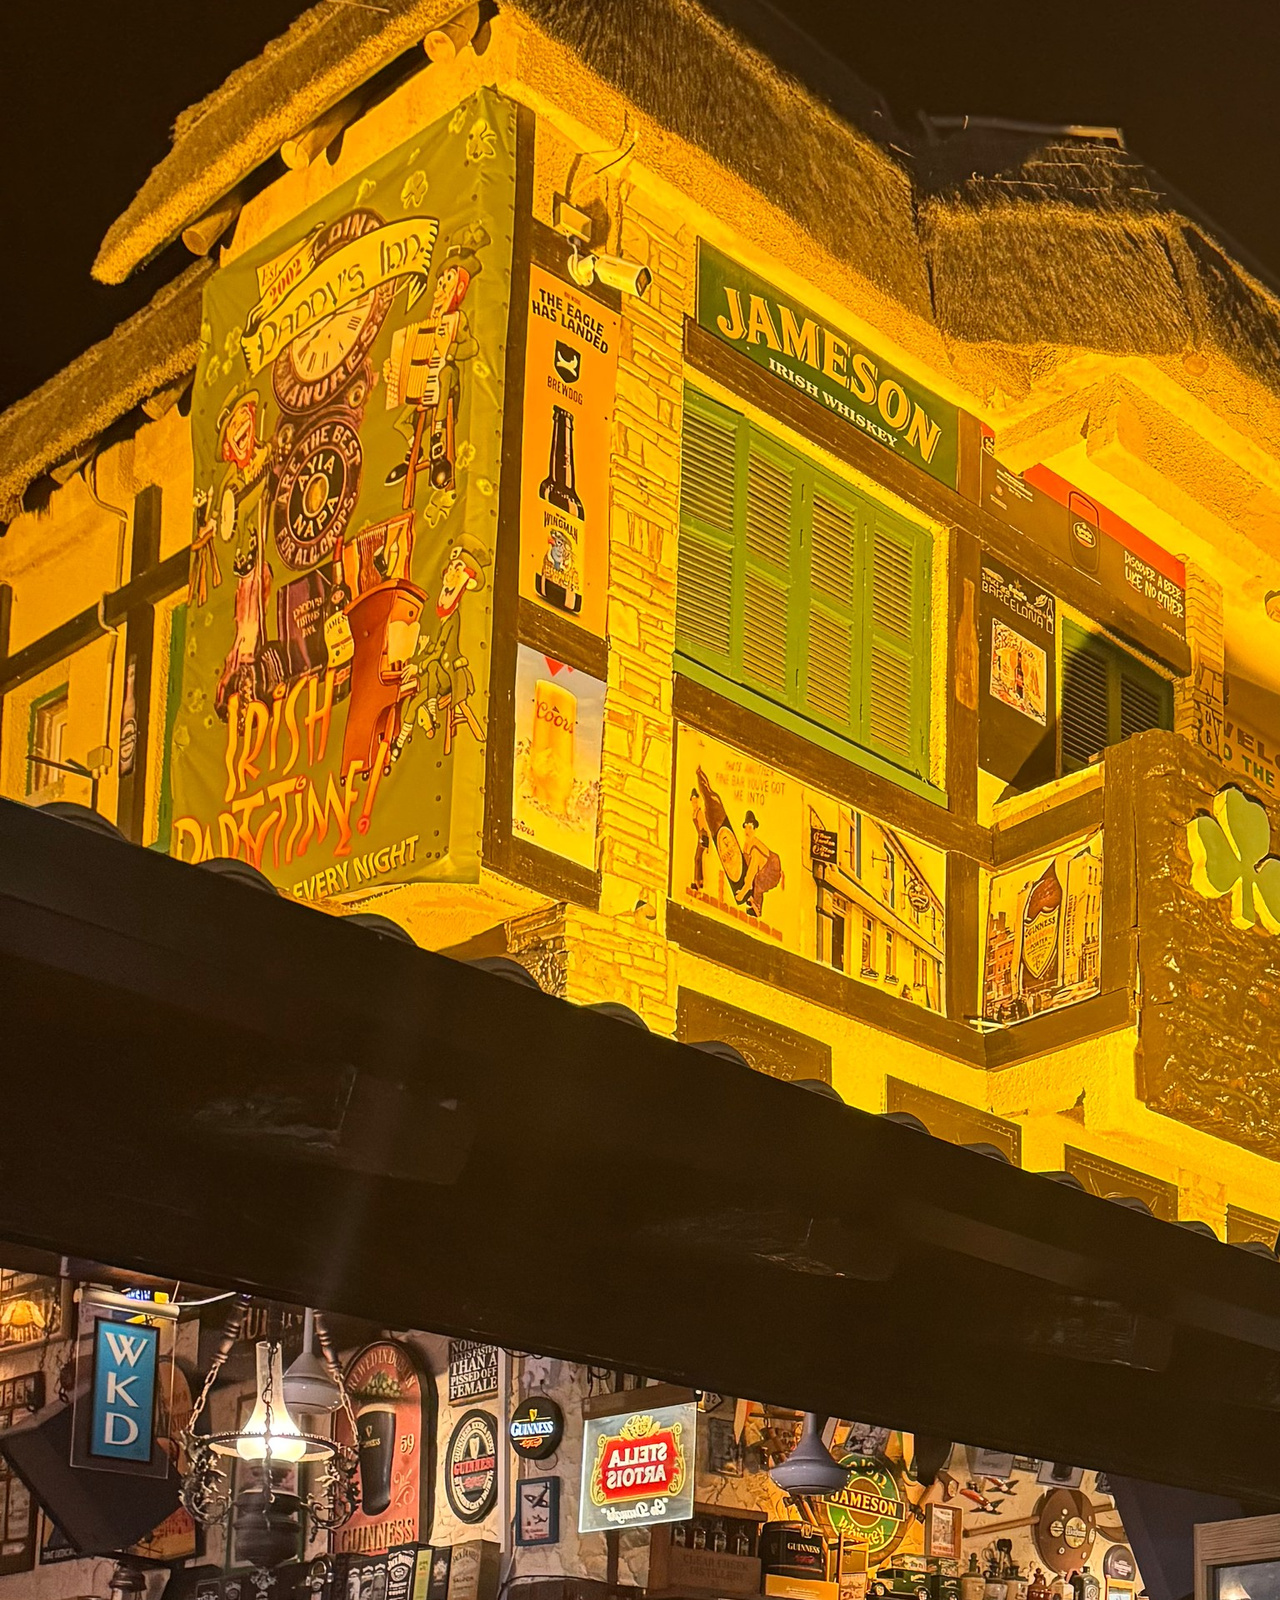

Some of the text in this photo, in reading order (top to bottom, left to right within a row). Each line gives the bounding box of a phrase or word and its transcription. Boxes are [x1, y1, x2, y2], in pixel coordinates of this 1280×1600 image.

[269, 258, 303, 307] 2002
[531, 300, 609, 355] HAS LANDED
[538, 287, 564, 311] THE
[566, 303, 605, 338] EAGLE
[547, 375, 584, 406] BREWDOG
[716, 286, 942, 464] JAMESON
[768, 357, 898, 449] IRISH WHISKEY
[277, 425, 362, 504] ARE THE BEST
[297, 453, 336, 492] AYIA
[293, 495, 340, 538] NAPA
[543, 510, 579, 546] WINGMAN
[1124, 550, 1156, 582] DISCOVER
[1157, 575, 1163, 589] A
[982, 580, 1044, 629] BARCELONA
[1125, 565, 1184, 618] LIKE NO OTHER
[225, 668, 335, 803] IRISH
[535, 700, 575, 735] Coors
[770, 781, 786, 797] GOT
[1241, 754, 1277, 790] THE
[733, 789, 766, 807] ME INTO
[512, 817, 536, 839] Coors
[292, 834, 420, 902] EVERY NIGHT
[1025, 916, 1056, 938] GUINNESS
[450, 1352, 498, 1377] THAN A
[472, 1344, 499, 1358] FASTER
[104, 1330, 150, 1446] WKD
[347, 1351, 379, 1391] REWED
[450, 1366, 498, 1387] PISSED OFF
[450, 1376, 498, 1400] FEMALE
[400, 1433, 416, 1455] 59
[510, 1420, 554, 1437] GUINNESS
[453, 1457, 495, 1476] GUINNESS
[830, 1490, 897, 1517] JAMESON
[341, 1518, 416, 1554] GUINNESS
[787, 1542, 821, 1555] GUINNESS
